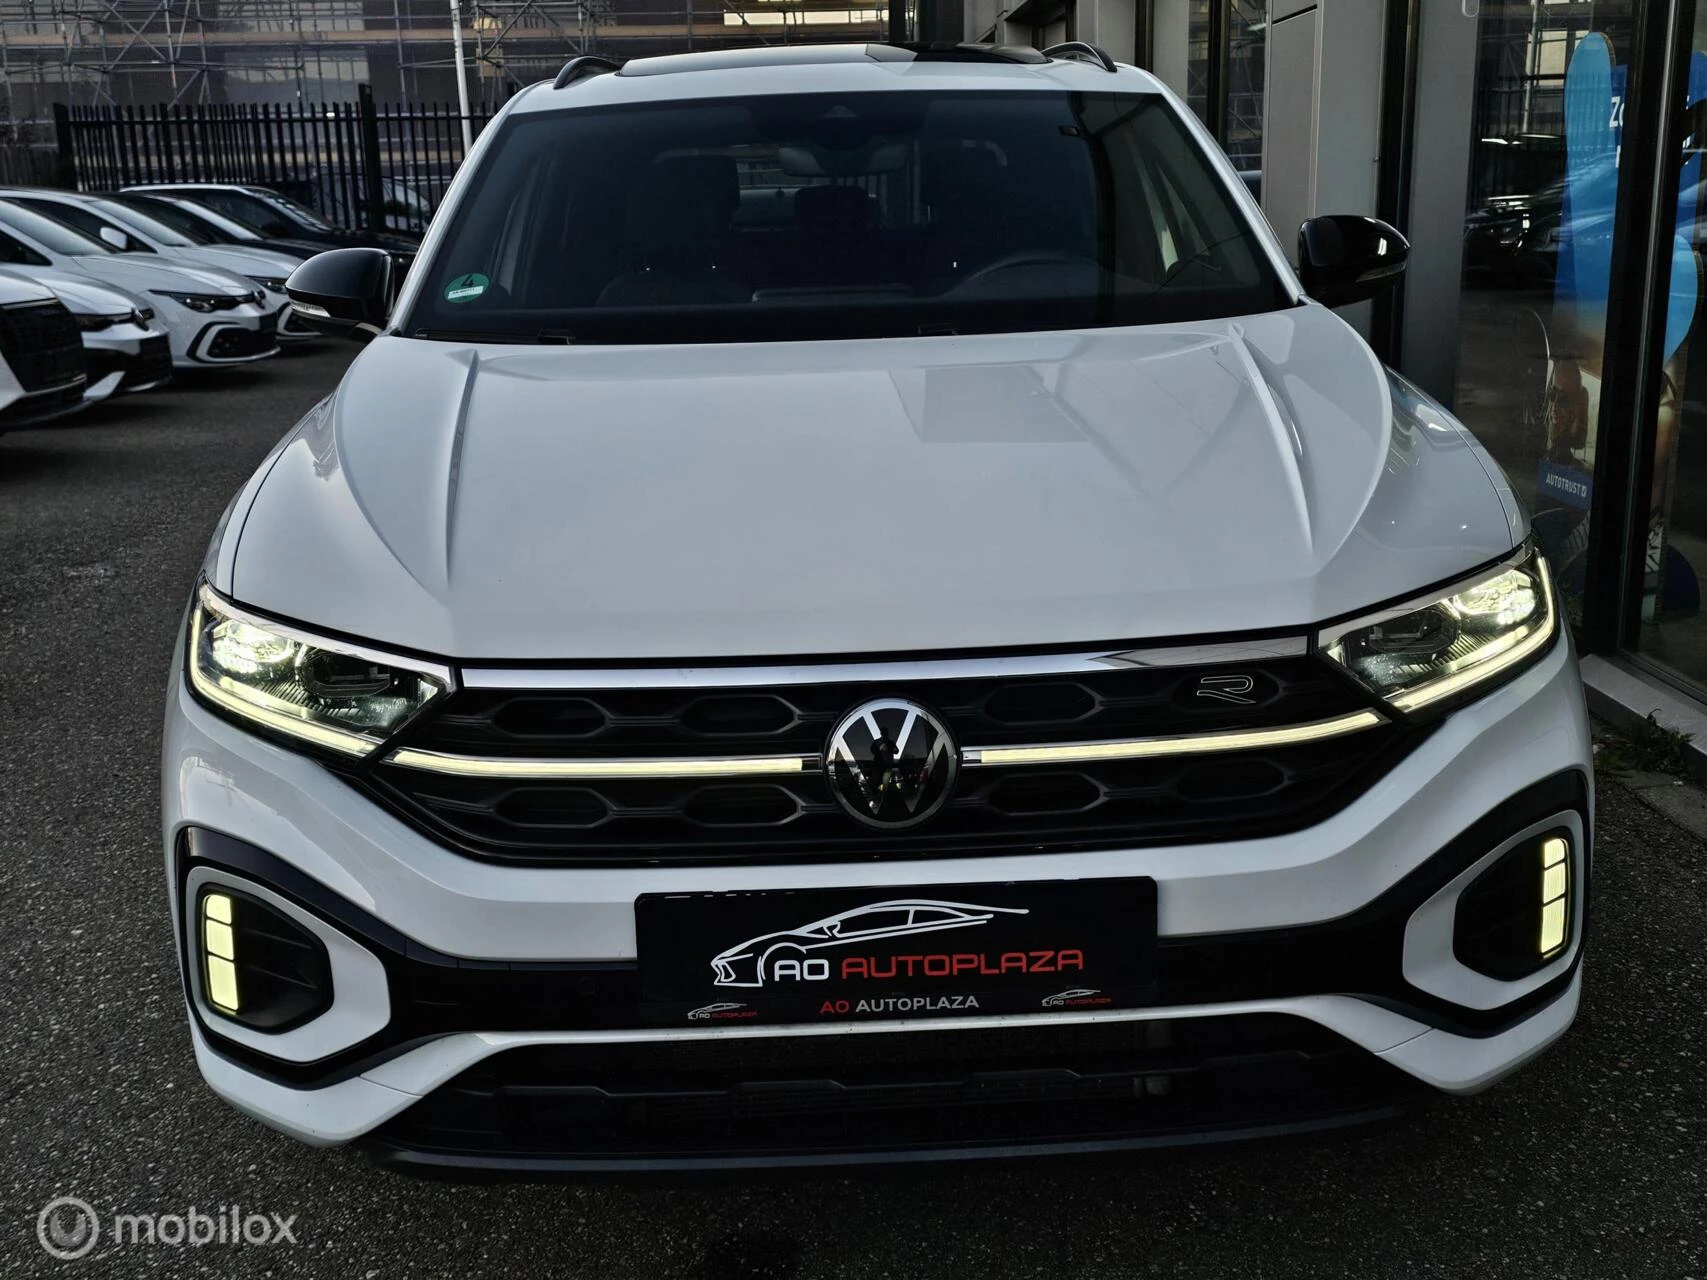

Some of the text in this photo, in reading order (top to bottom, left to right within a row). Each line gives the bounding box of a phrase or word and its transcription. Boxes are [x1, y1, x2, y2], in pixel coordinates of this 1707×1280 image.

[461, 274, 474, 288] 4
[1545, 473, 1581, 496] AUTOTRUST
[774, 949, 1084, 982] AO AUTOPLAZA
[820, 995, 980, 1014] AO AUTOPLAZA
